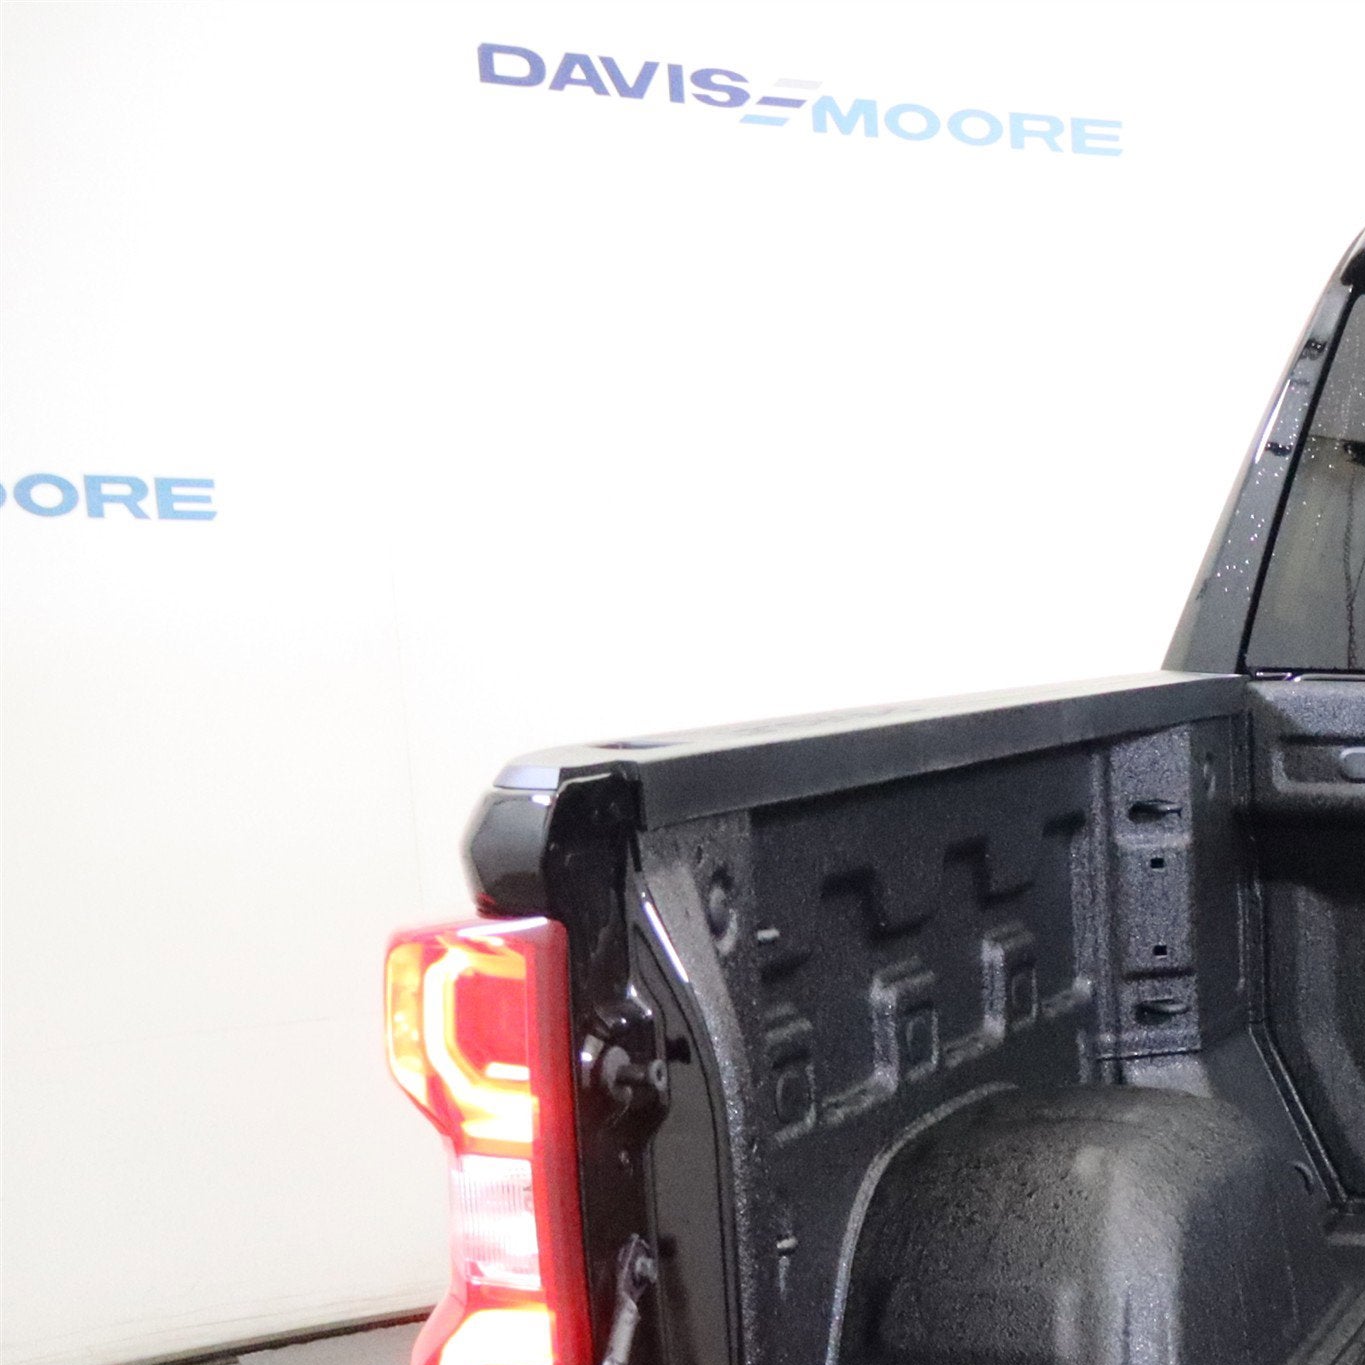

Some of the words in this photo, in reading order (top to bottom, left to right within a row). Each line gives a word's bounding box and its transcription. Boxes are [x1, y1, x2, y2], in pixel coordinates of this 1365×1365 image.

[476, 41, 752, 109] DAVIS
[810, 95, 1123, 158] MOORE
[0, 471, 218, 521] ORE
